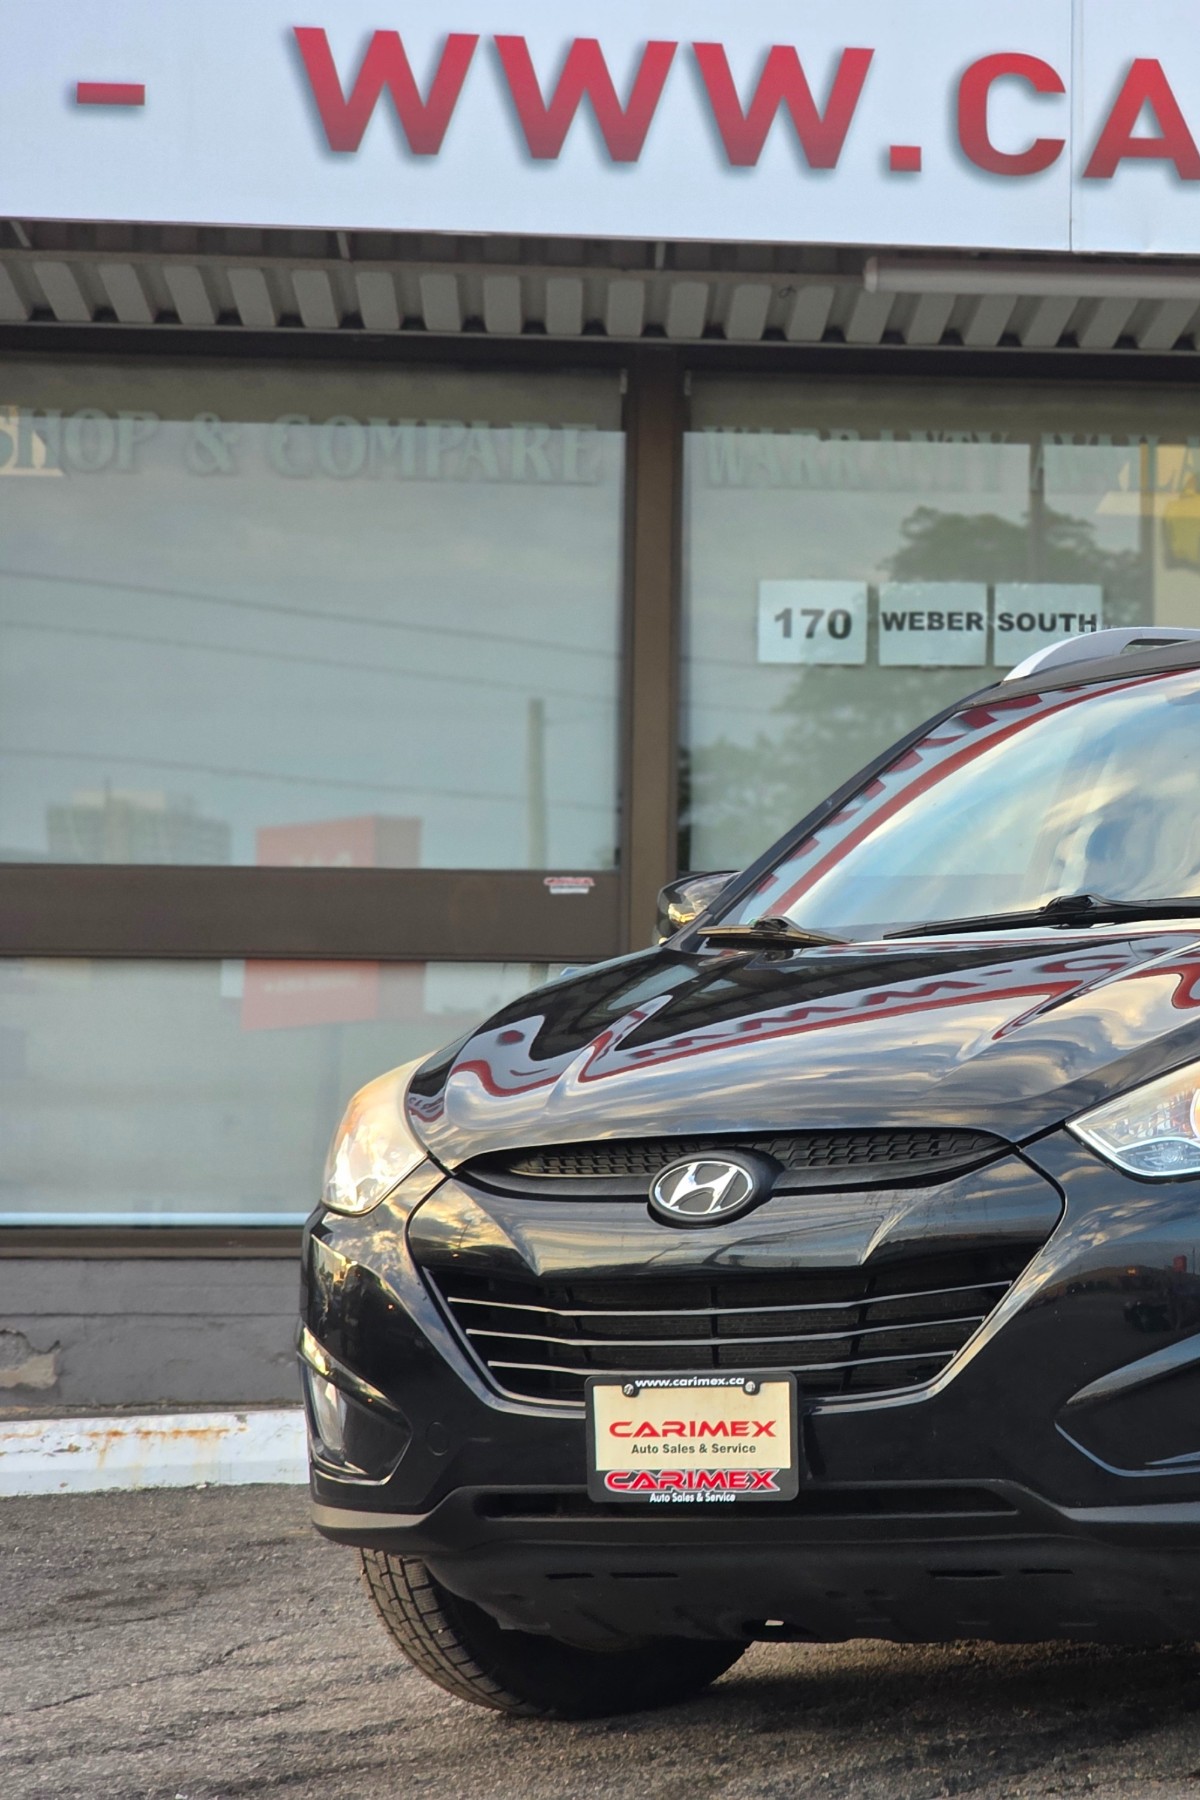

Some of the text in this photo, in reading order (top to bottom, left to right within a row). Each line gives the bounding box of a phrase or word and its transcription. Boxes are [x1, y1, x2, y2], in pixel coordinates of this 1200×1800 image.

[190, 411, 238, 475] &
[268, 414, 598, 484] COMPARE
[774, 608, 1098, 640] 170 WEBER SOUTH
[634, 1376, 745, 1388] www.carimex.ca
[608, 1420, 777, 1438] CARIMEX
[631, 1442, 757, 1454] Auto Sales & Service
[605, 1469, 780, 1492] CARIMEX
[650, 1491, 736, 1503] Auto Sales & Service
